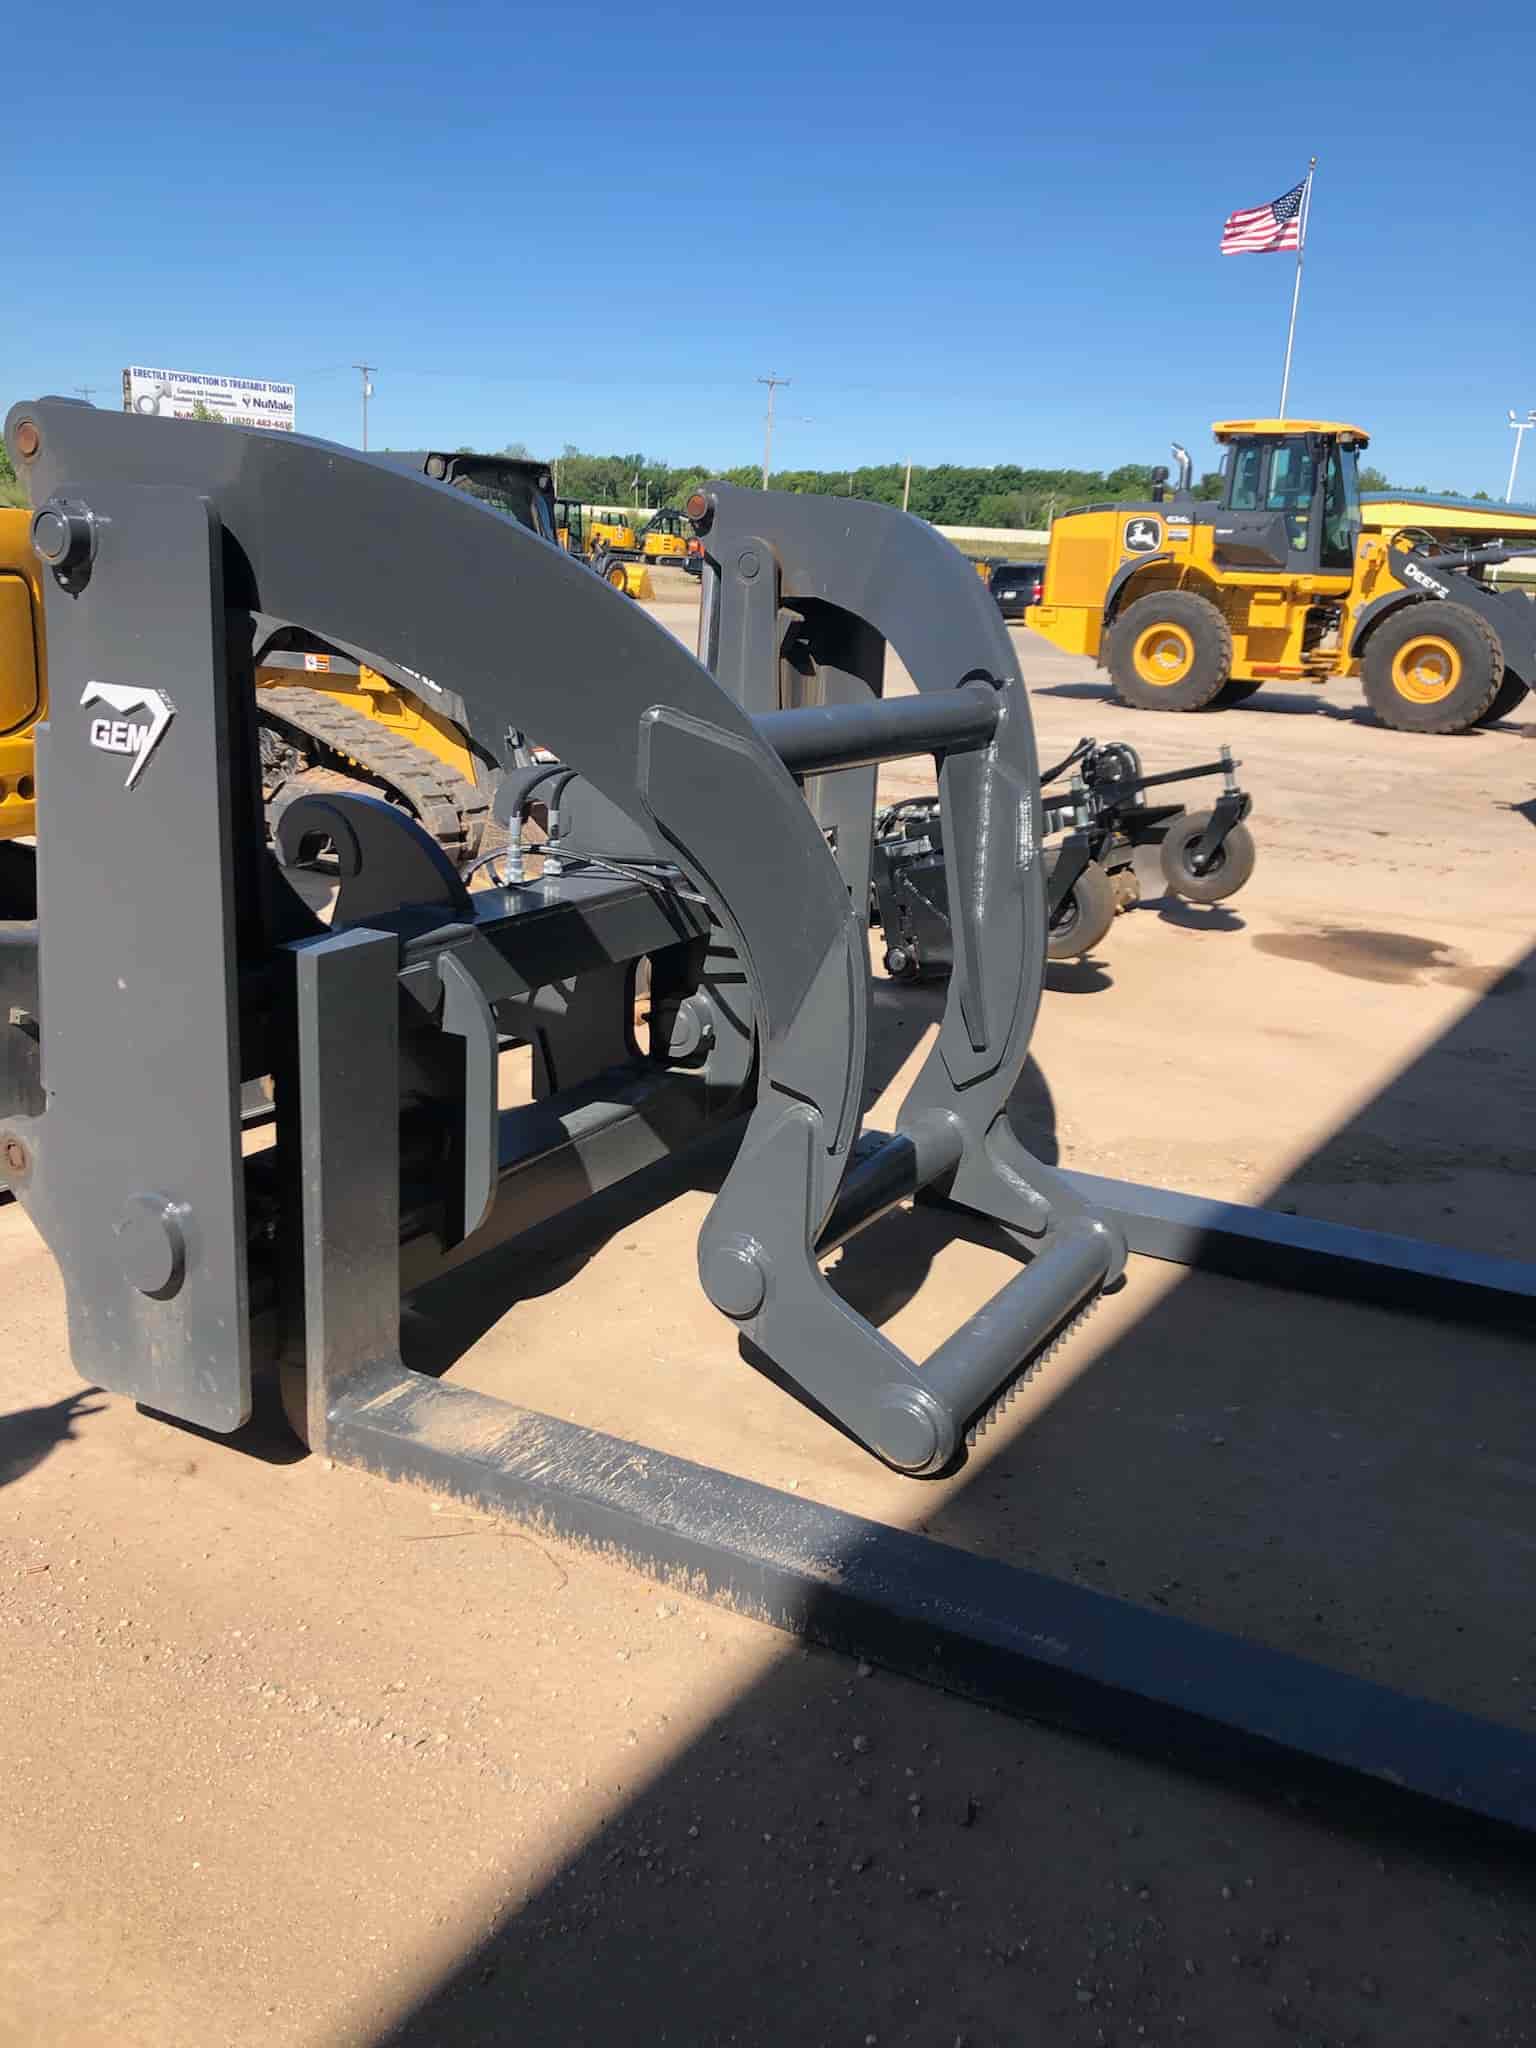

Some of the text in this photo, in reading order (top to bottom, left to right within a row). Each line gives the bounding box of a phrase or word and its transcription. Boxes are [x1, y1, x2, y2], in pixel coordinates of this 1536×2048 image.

[133, 368, 166, 380] ERECTILE
[168, 372, 219, 386] DYSFUNCTION
[220, 378, 228, 388] IS
[229, 379, 267, 392] TREATABLE
[253, 397, 293, 411] NuMale
[1404, 563, 1449, 599] DEERE
[90, 719, 149, 752] GEM
